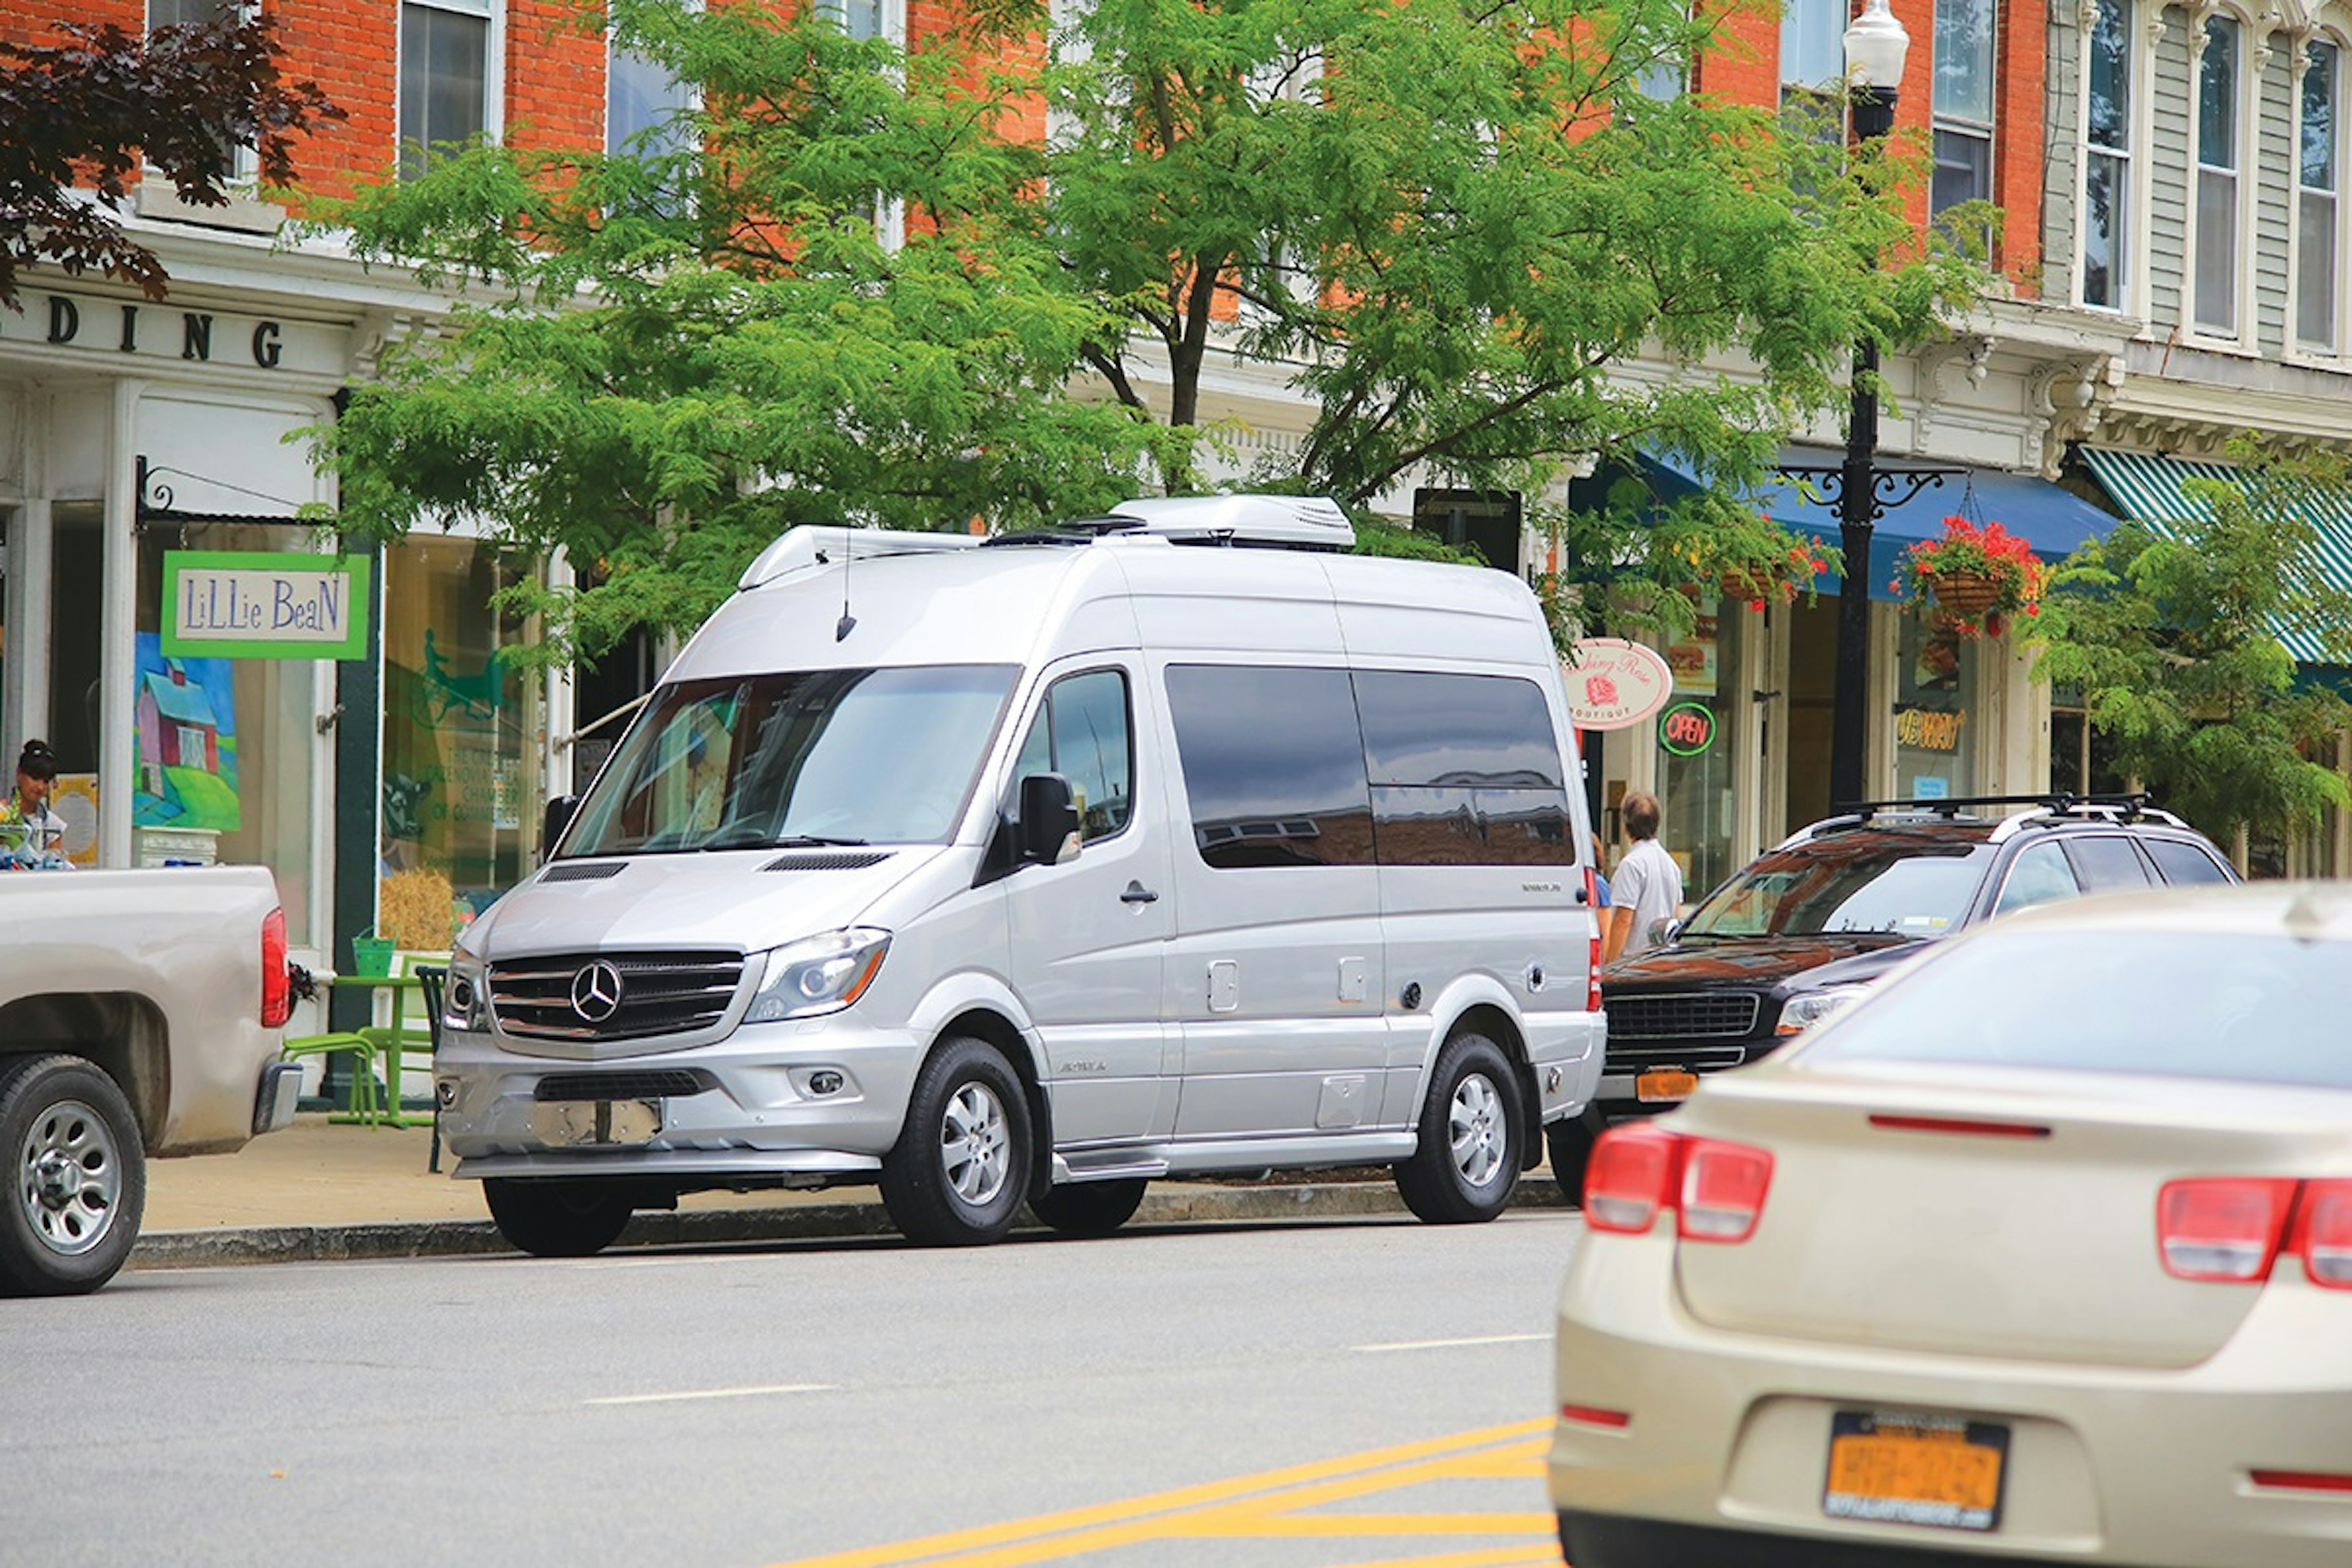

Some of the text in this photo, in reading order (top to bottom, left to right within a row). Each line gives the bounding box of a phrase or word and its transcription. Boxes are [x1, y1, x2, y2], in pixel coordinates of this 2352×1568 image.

[0, 296, 282, 368] DING
[271, 579, 341, 631] BeaN
[1617, 655, 1651, 686] Rose
[1666, 712, 1709, 745] OPEN
